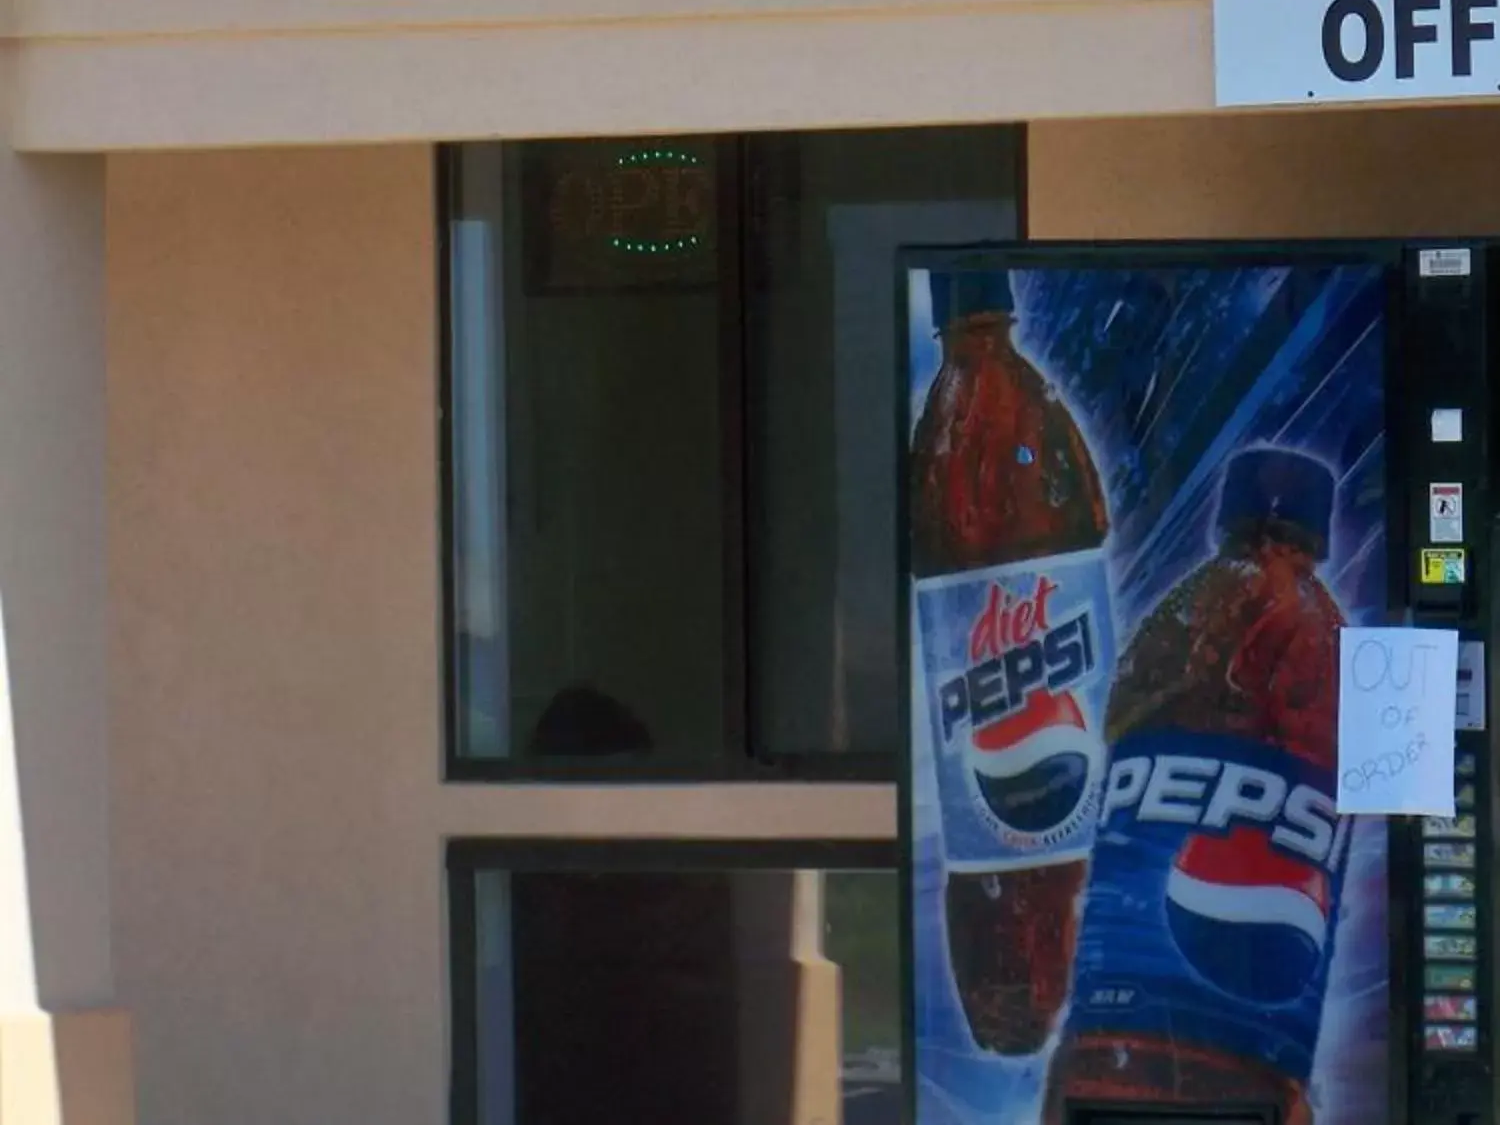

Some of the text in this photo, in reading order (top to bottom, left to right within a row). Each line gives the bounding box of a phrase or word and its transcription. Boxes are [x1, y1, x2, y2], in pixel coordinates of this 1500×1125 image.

[970, 575, 1058, 664] diet
[939, 612, 1095, 743] PEPSI
[1351, 639, 1440, 697] OUT
[1380, 704, 1421, 730] OF
[1100, 754, 1354, 873] PEPSI
